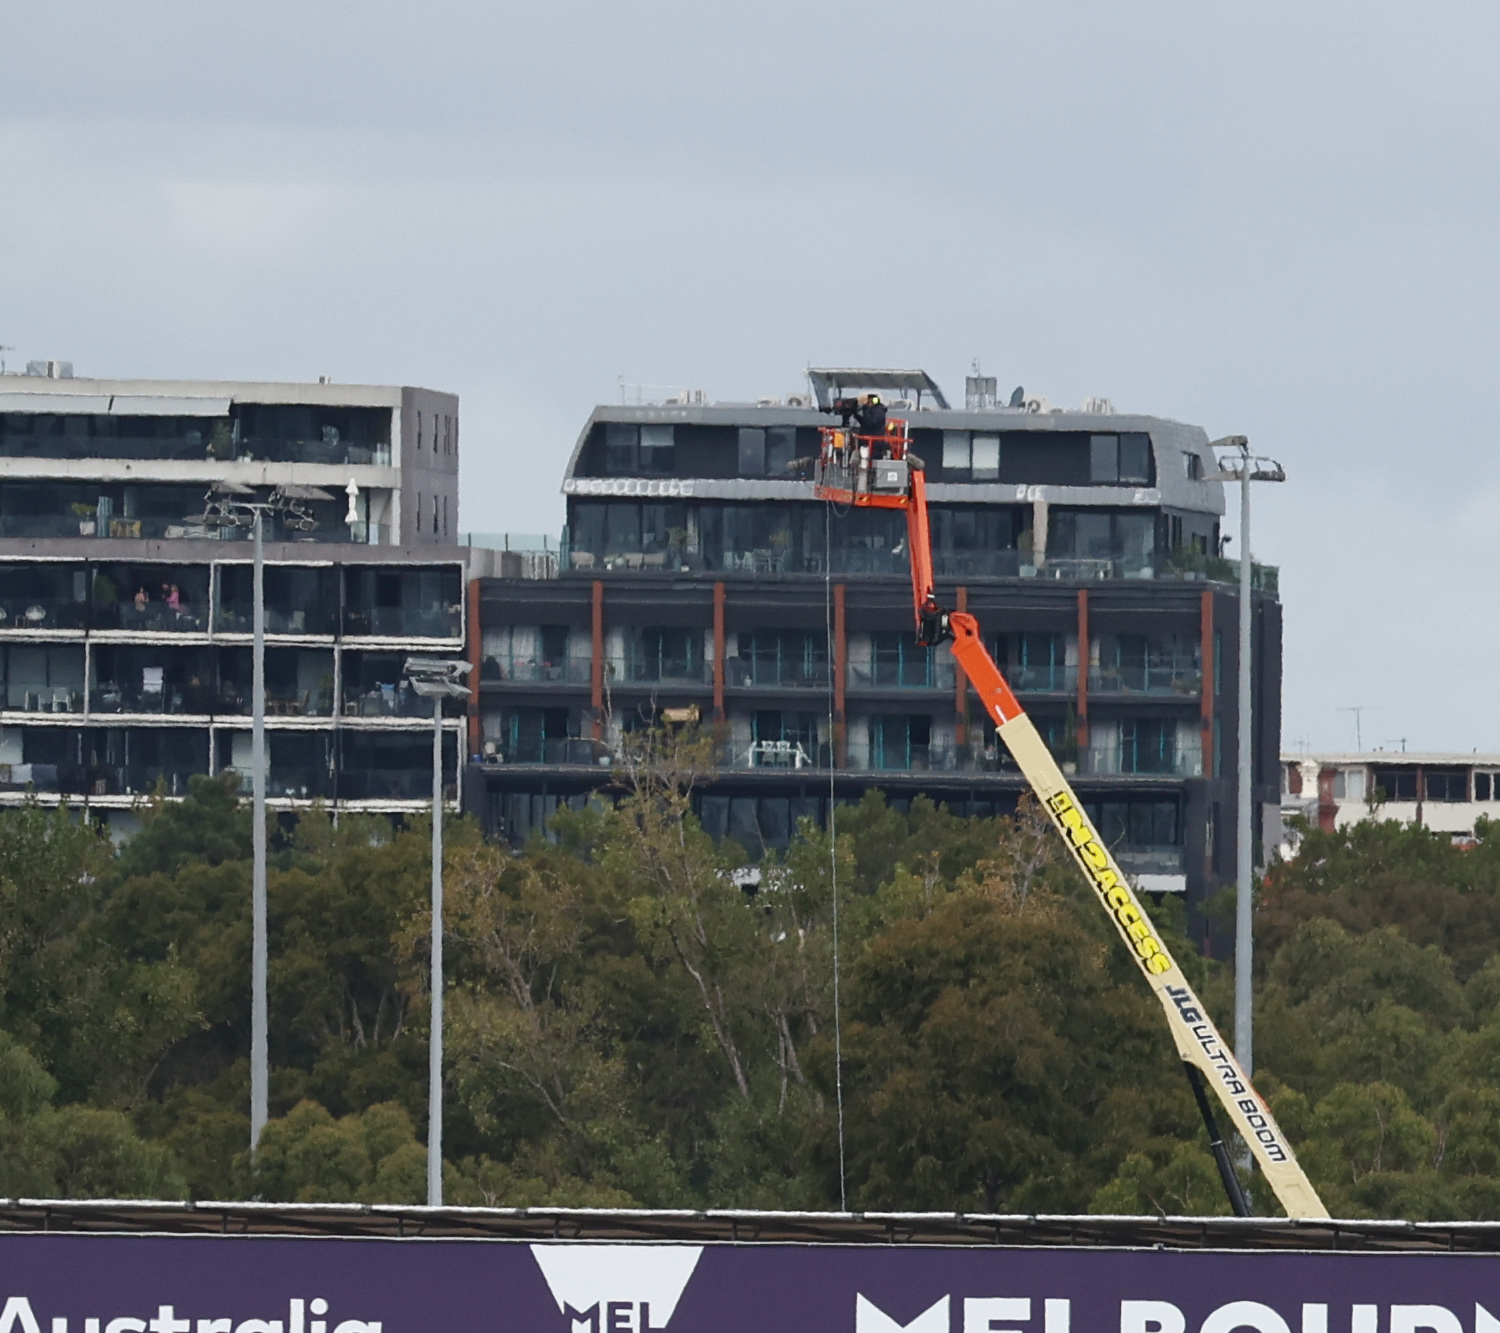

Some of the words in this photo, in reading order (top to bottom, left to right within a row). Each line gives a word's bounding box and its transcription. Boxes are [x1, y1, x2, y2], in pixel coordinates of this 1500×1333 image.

[1164, 983, 1204, 1024] JLG
[1192, 1025, 1248, 1096] ULTRA
[1237, 1098, 1288, 1163] BOOM
